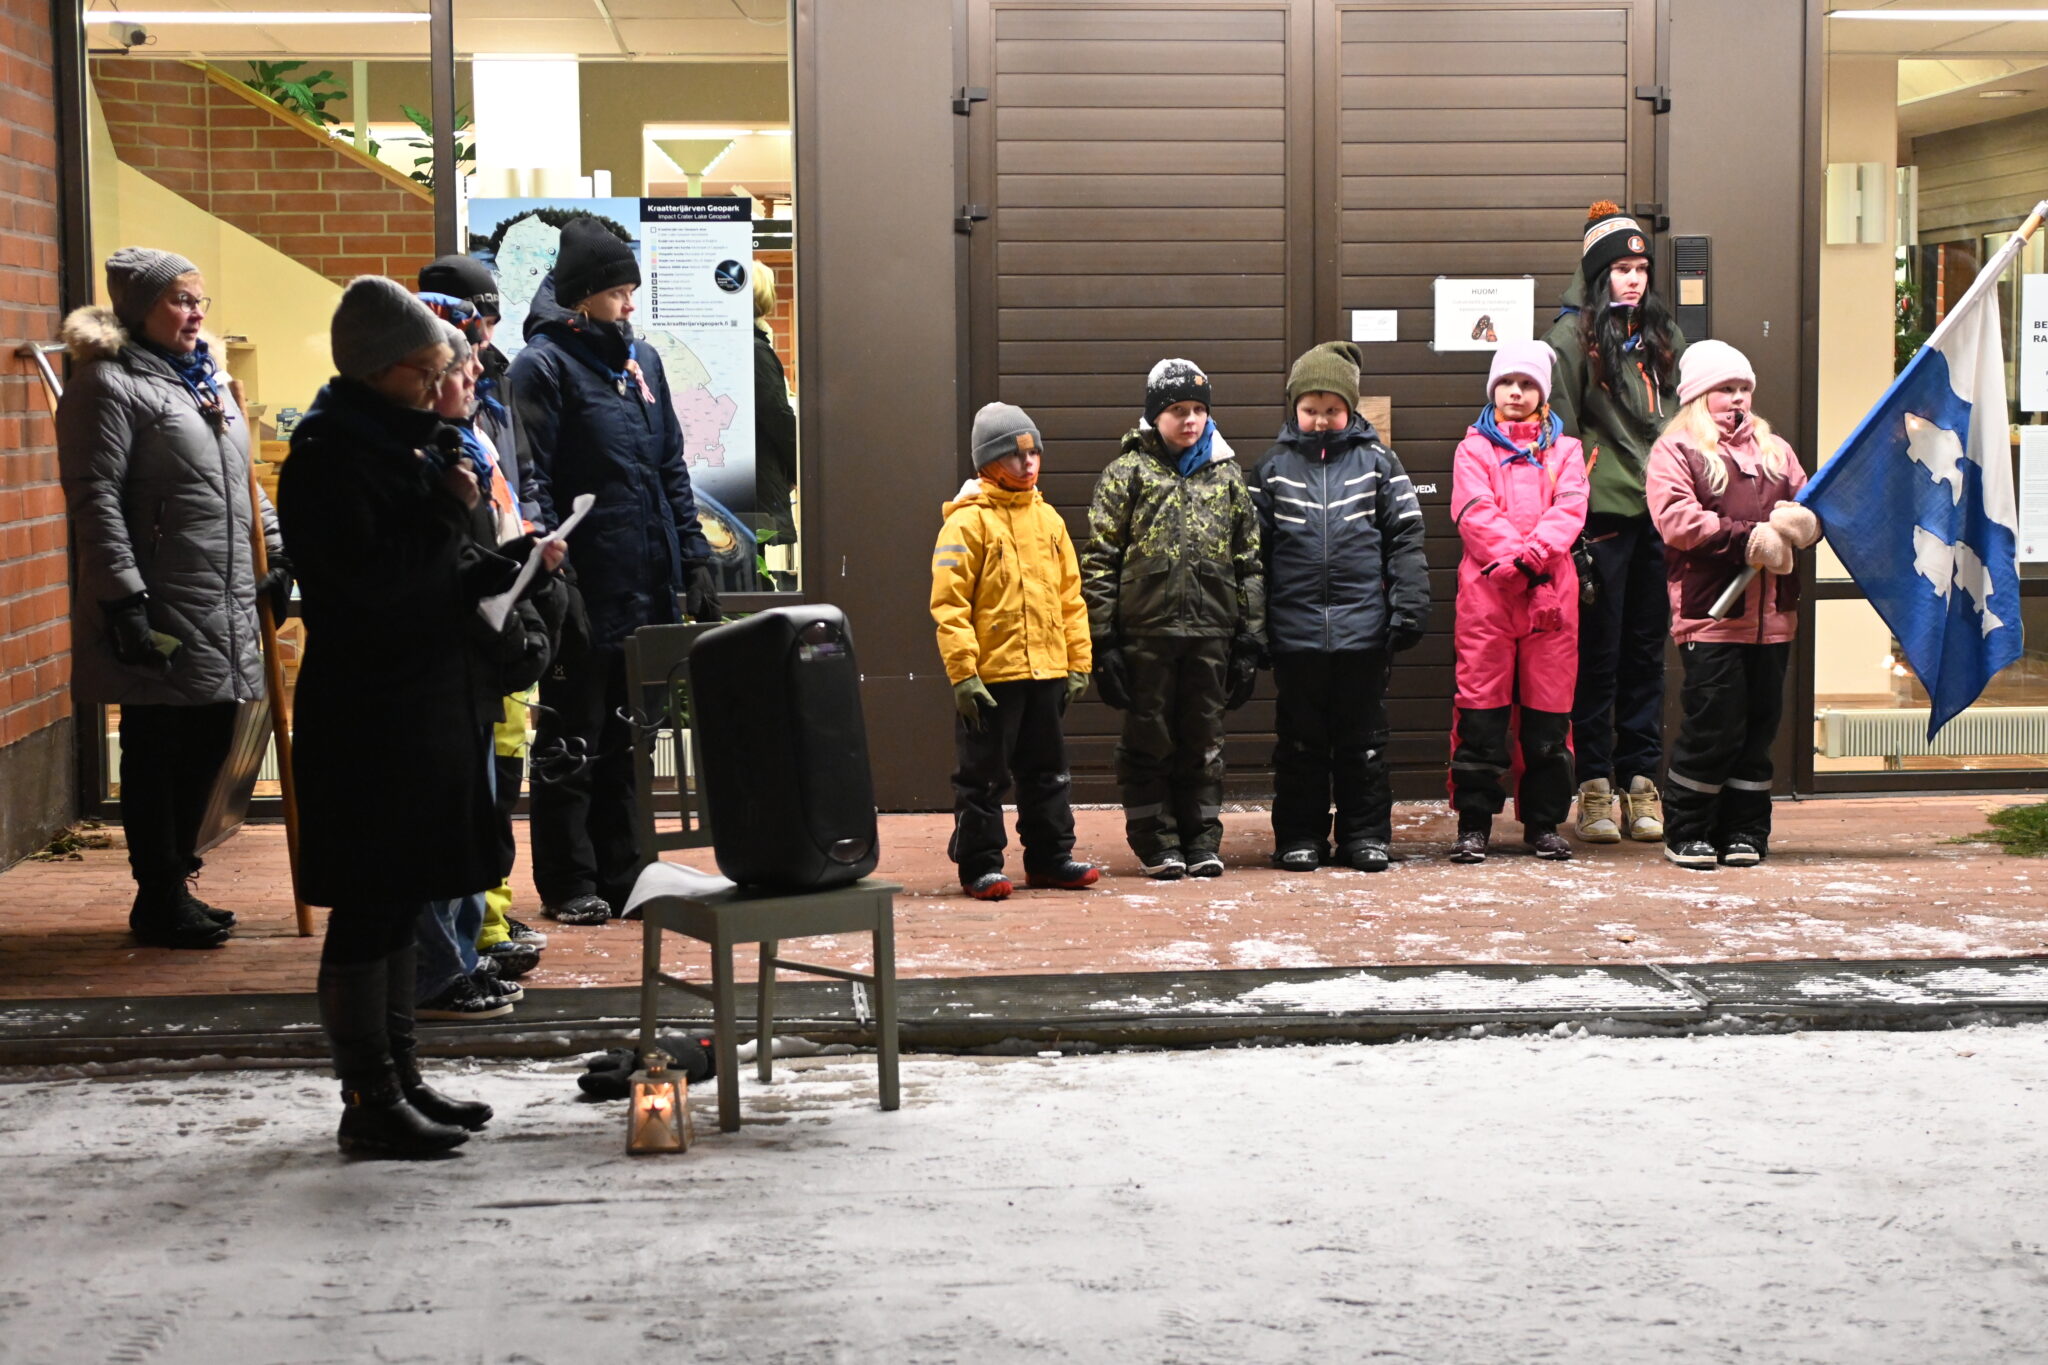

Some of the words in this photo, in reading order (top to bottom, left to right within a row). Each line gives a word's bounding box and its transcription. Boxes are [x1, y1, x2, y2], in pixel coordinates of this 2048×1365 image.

[647, 204, 706, 213] Kraatterijärven
[707, 204, 740, 213] Geopark
[1413, 483, 1437, 494] VEDÄ
